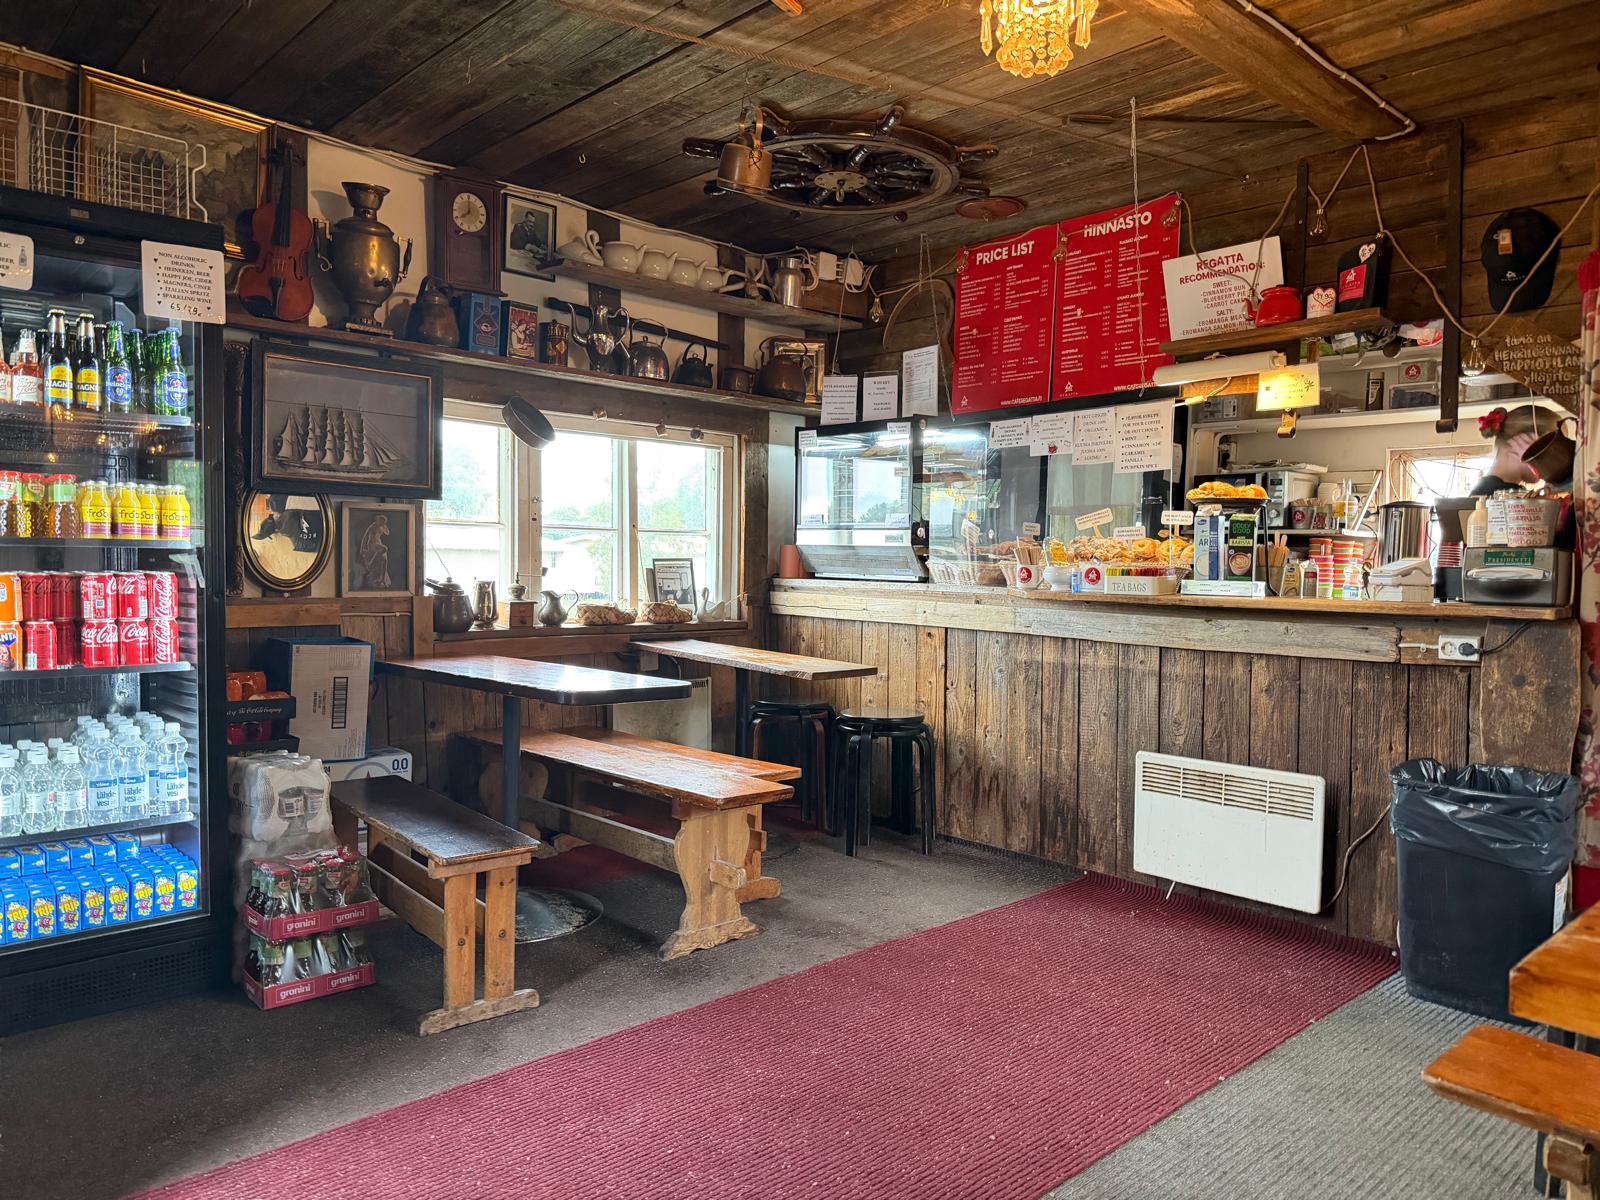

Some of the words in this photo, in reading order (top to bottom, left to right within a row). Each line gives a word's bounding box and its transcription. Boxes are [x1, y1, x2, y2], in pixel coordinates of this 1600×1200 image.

[1084, 211, 1152, 238] HINNASTO
[976, 246, 1008, 266] PRICE
[1012, 241, 1034, 256] LIST
[1196, 252, 1244, 272] REGATTA
[1180, 262, 1266, 285] RECOMMENDATION:
[1112, 582, 1126, 592] TEA
[1127, 584, 1147, 592] BAGS
[392, 758, 408, 770] 0.0
[156, 881, 175, 895] TRIP
[178, 876, 197, 891] TRIP
[108, 891, 128, 905] TRIP
[134, 887, 153, 901] TRIP
[59, 900, 80, 914] TRIP
[84, 895, 104, 909] TRIP
[7, 908, 29, 922] TRIP
[34, 904, 54, 918] TRIP
[336, 908, 365, 922] granini
[286, 918, 316, 931] granini
[330, 972, 361, 987] granini
[280, 984, 311, 1000] granini
